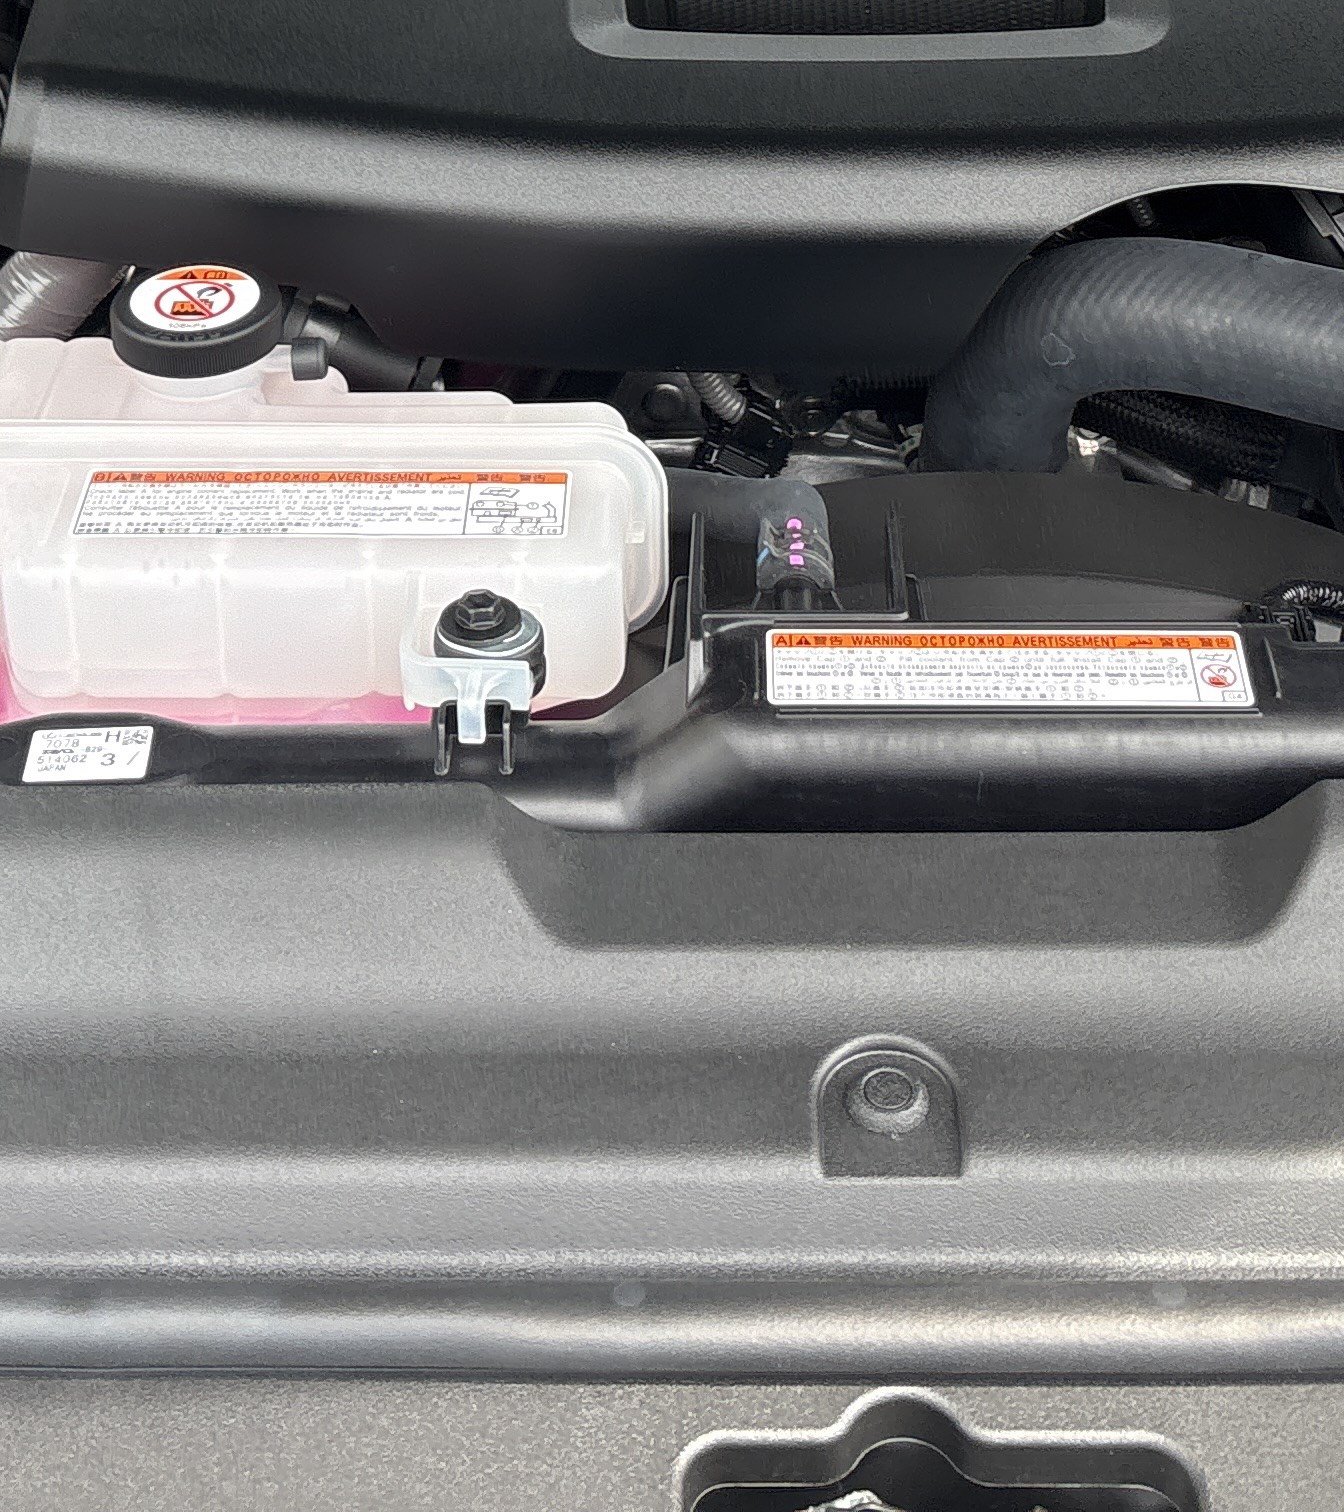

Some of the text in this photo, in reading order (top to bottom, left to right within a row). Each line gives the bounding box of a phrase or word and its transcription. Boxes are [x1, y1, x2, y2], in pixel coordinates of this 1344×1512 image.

[165, 472, 226, 482] WARNING
[328, 472, 433, 482] AVERTISSEMENT
[775, 637, 788, 646] A
[851, 637, 913, 646] WARNING
[920, 637, 1005, 646] ОСТОРОЖНО
[1012, 637, 1117, 647] AVERTISSEMENT
[105, 730, 122, 743] H
[45, 738, 80, 748] 7078
[100, 753, 116, 766] 3
[37, 764, 67, 772] JAPAN
